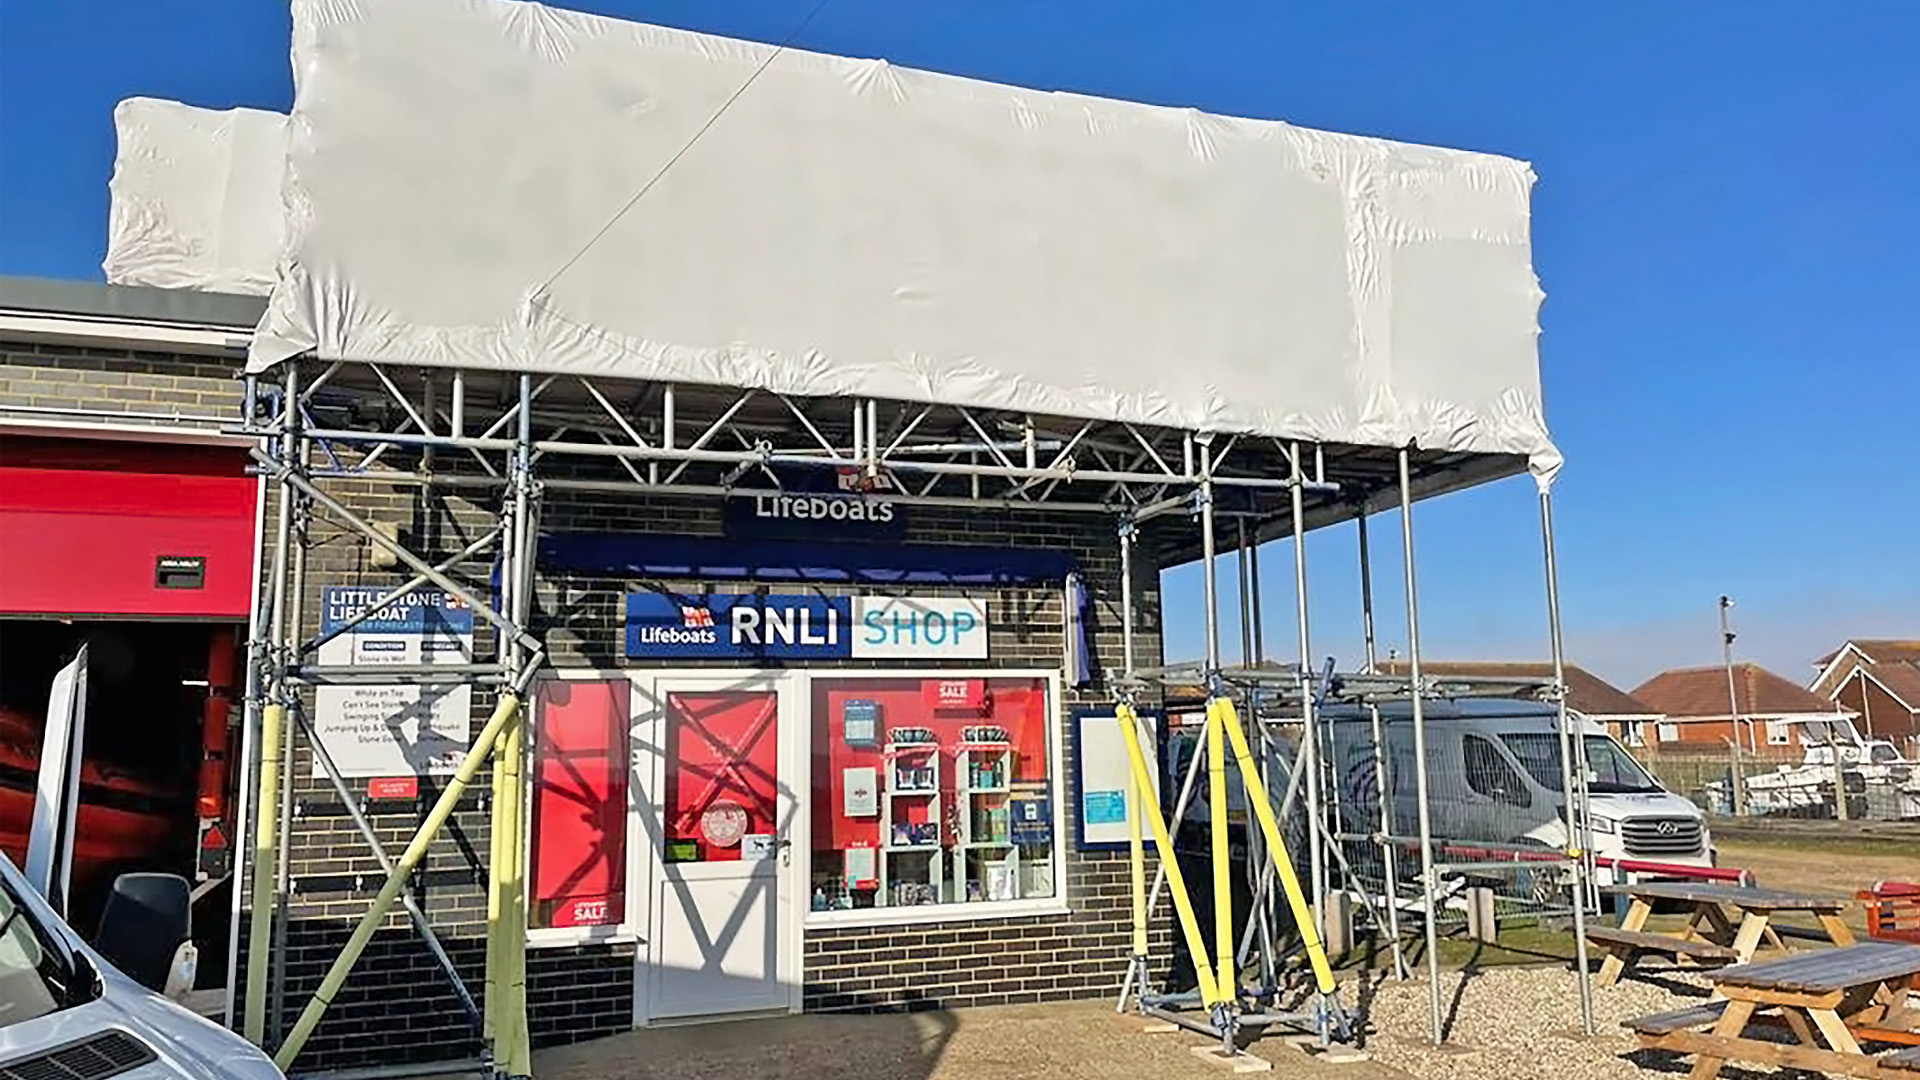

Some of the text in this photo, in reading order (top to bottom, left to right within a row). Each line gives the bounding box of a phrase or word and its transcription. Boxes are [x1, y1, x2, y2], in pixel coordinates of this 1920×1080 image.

[756, 495, 893, 522] Lifeboats
[330, 591, 441, 606] LITTLETONE
[641, 606, 976, 645] Lifeboats RNLI SHOP
[938, 686, 968, 698] SALE
[574, 908, 608, 920] SALE
